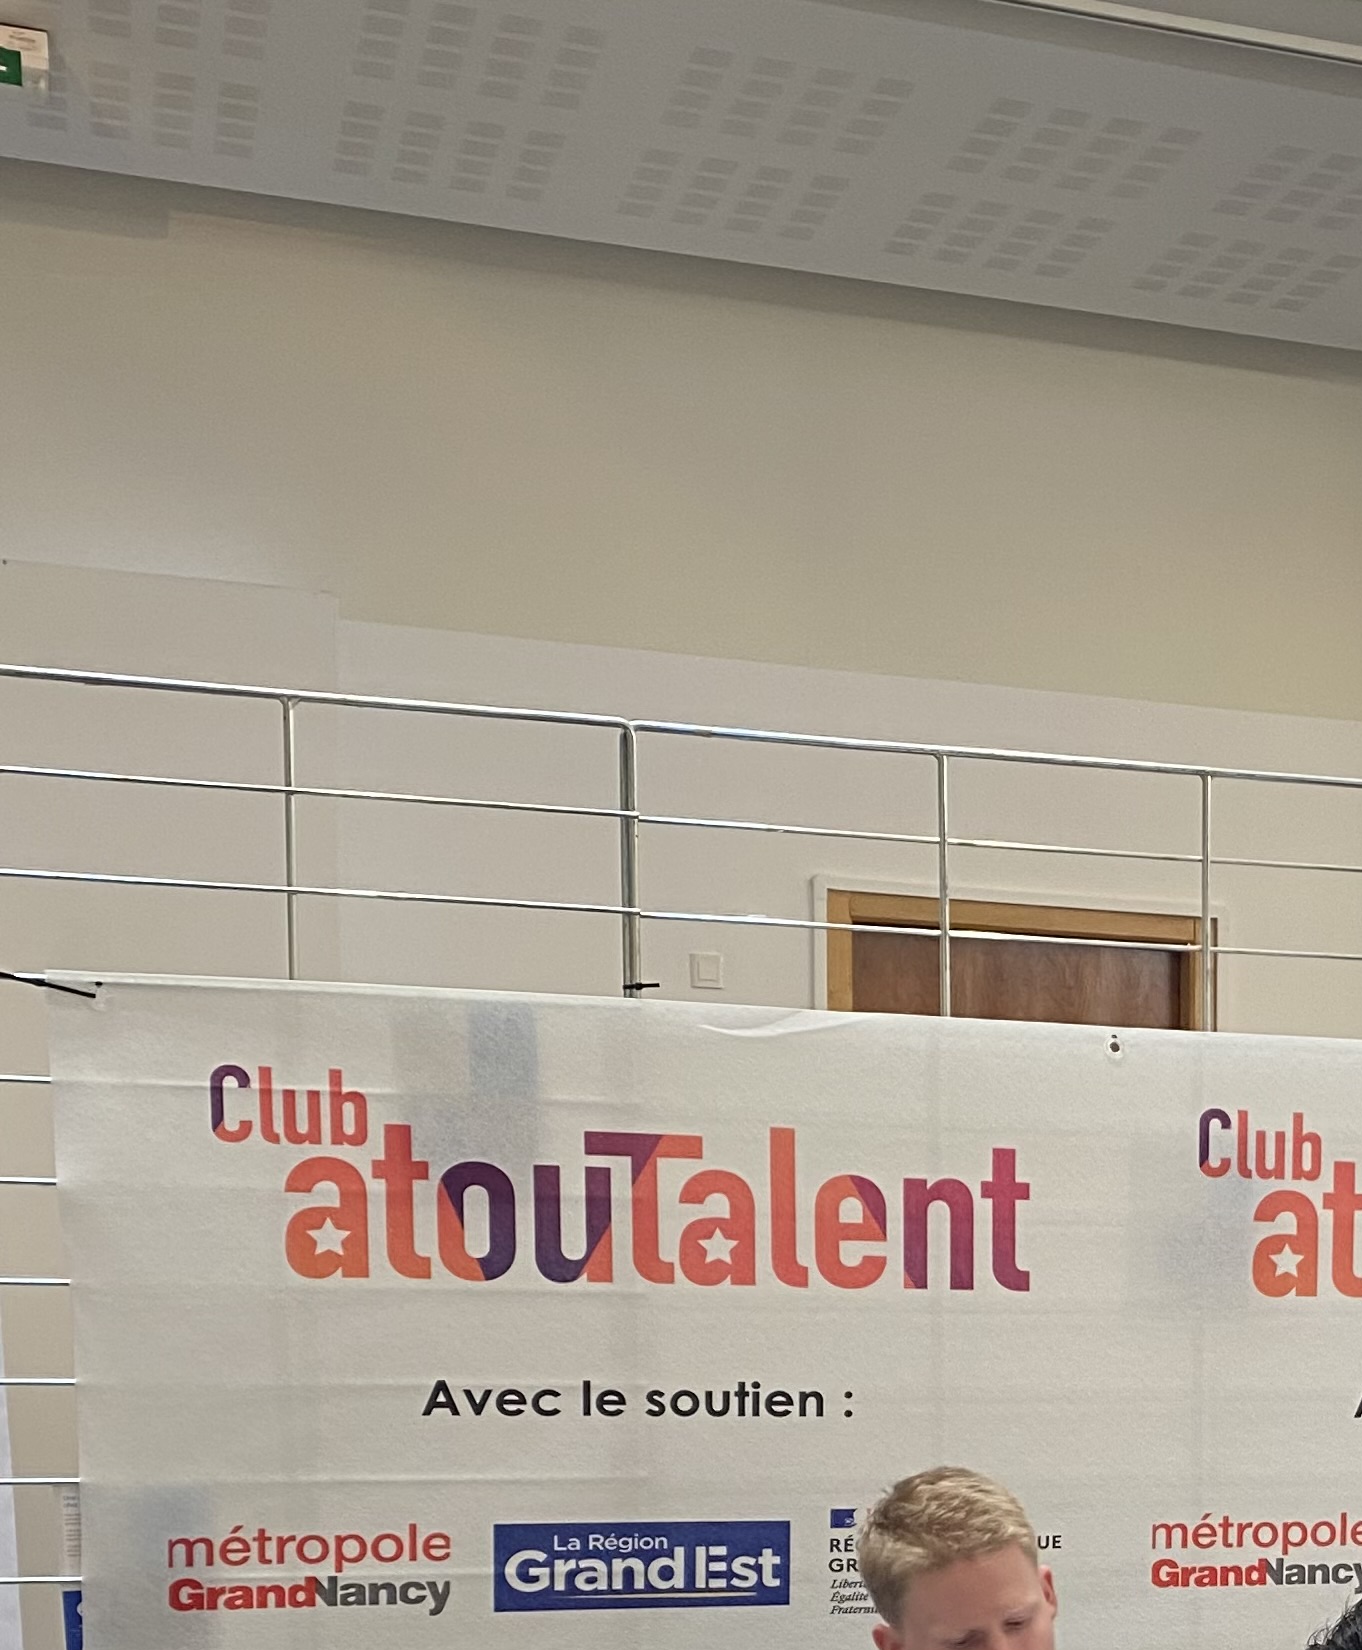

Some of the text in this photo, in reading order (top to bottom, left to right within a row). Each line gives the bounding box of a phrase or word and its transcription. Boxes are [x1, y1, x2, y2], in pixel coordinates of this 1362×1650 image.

[209, 1063, 368, 1146] Club
[1199, 1107, 1323, 1182] Club
[284, 1123, 1032, 1293] atouTalent
[422, 1379, 562, 1418] Avec
[582, 1379, 627, 1418] le
[645, 1380, 825, 1418] soutien
[168, 1523, 451, 1574] métropole
[553, 1533, 668, 1553] La Région
